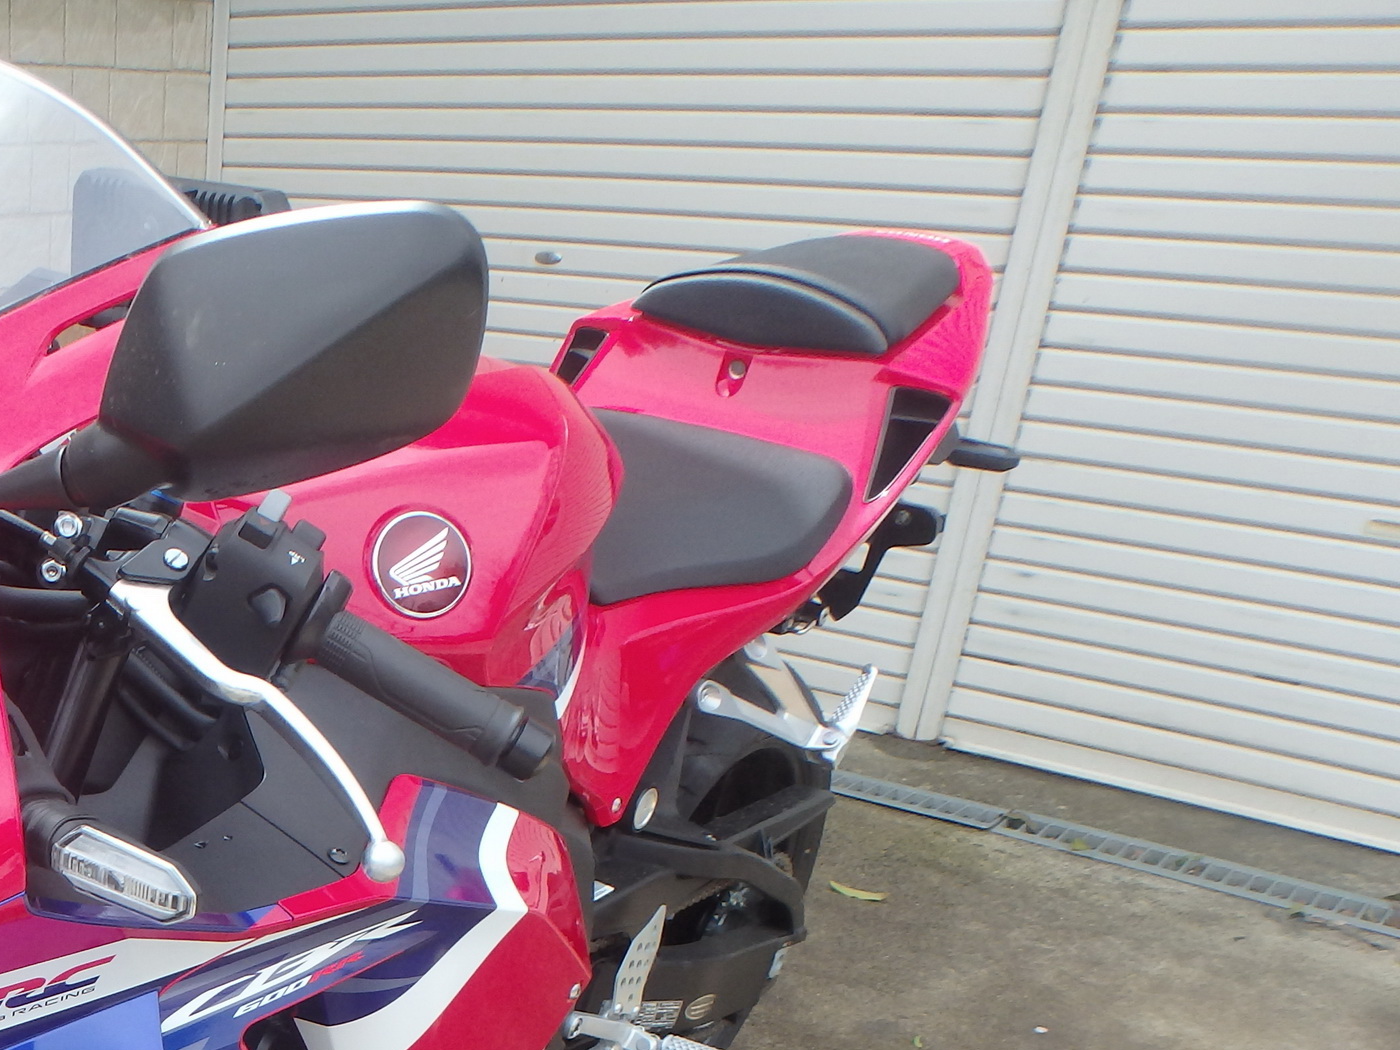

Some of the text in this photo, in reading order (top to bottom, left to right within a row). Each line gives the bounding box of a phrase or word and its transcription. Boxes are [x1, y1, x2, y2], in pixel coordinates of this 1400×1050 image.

[393, 576, 462, 600] HONDA
[160, 909, 424, 1033] CBR
[11, 985, 96, 1017] RACING
